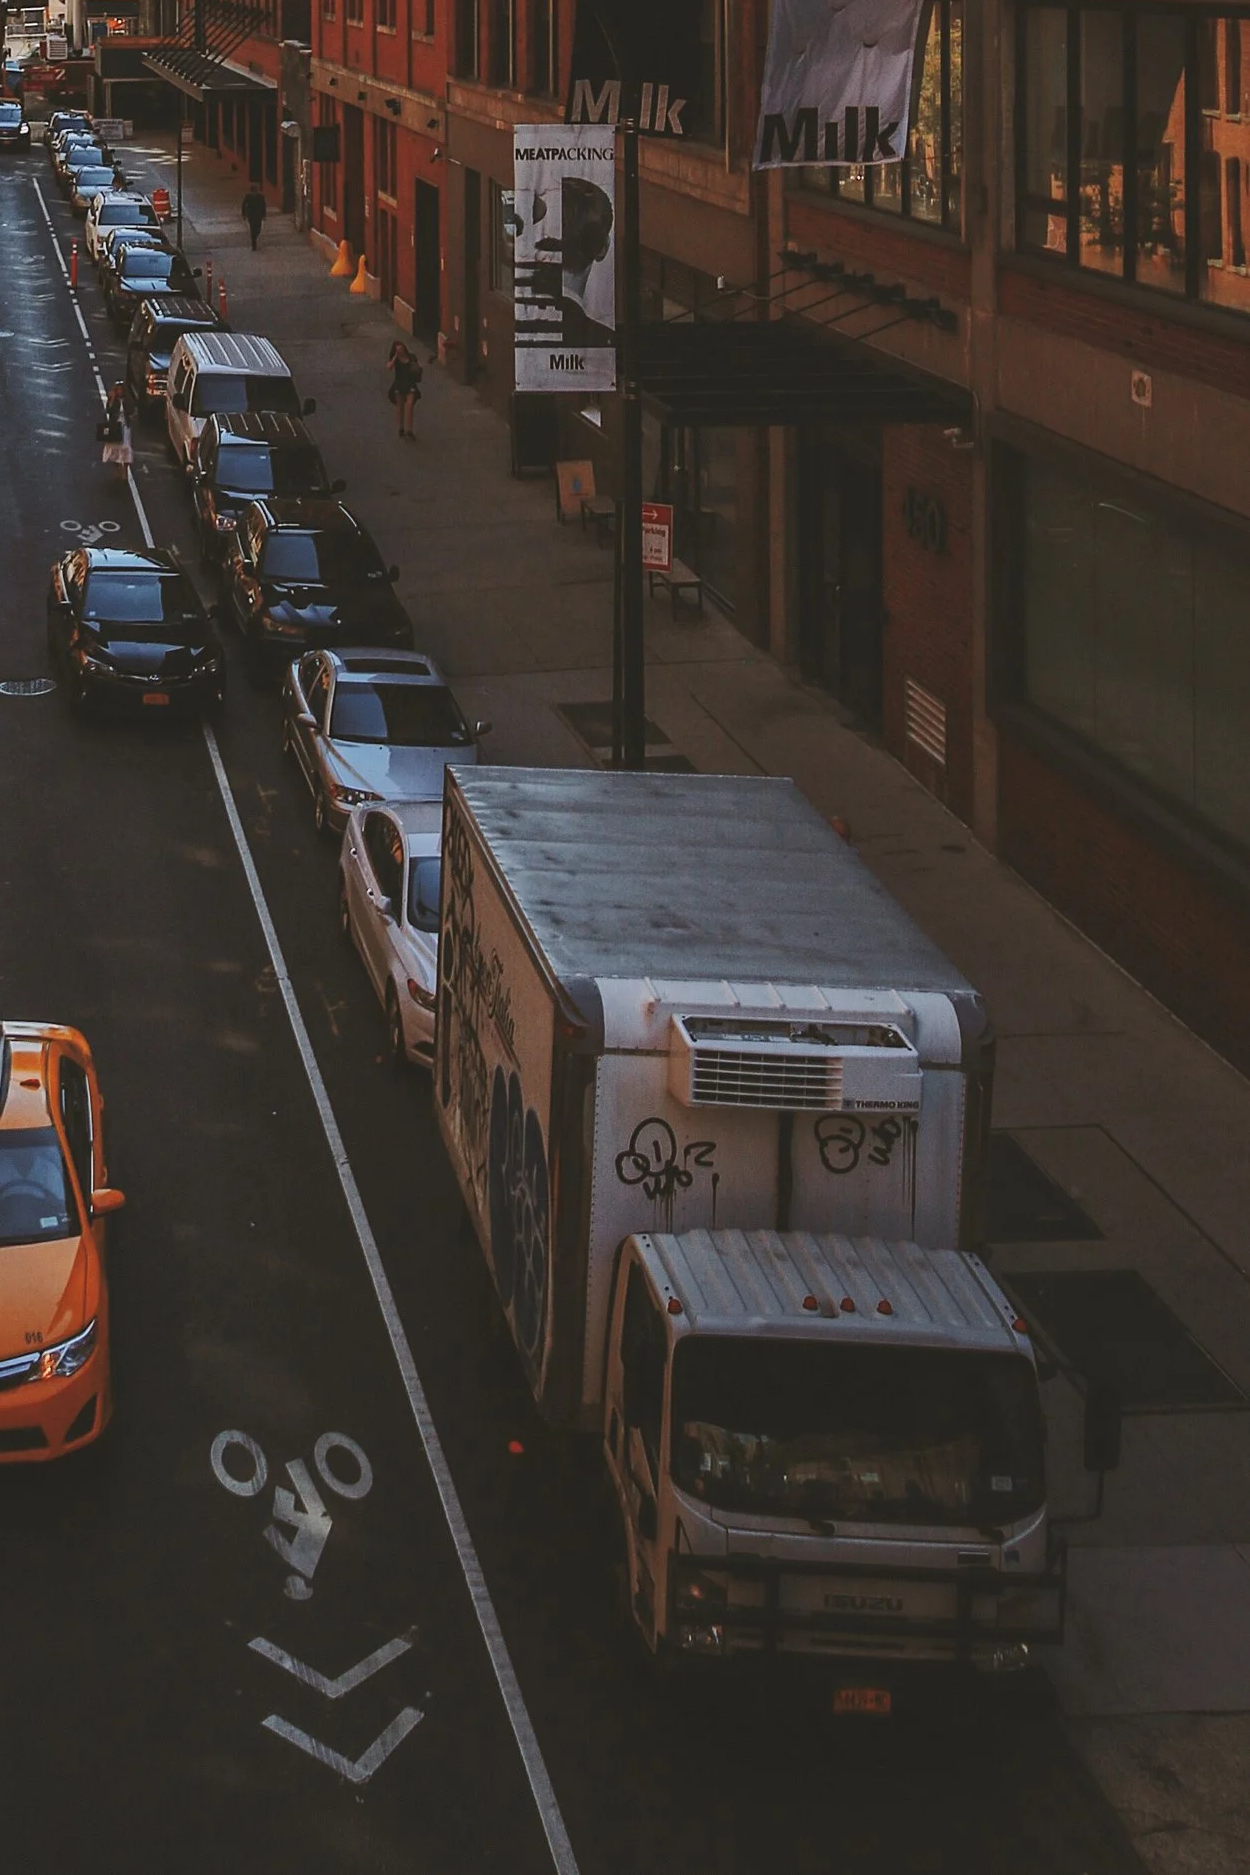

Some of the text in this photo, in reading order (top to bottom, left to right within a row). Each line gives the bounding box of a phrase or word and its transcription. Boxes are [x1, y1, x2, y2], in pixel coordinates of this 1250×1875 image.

[571, 79, 688, 135] Mlk
[760, 105, 900, 162] Milk
[515, 147, 614, 161] MEATPACKING
[549, 354, 585, 370] Milk
[855, 1100, 919, 1109] THERMO KING
[824, 1594, 903, 1611] ISUZU
